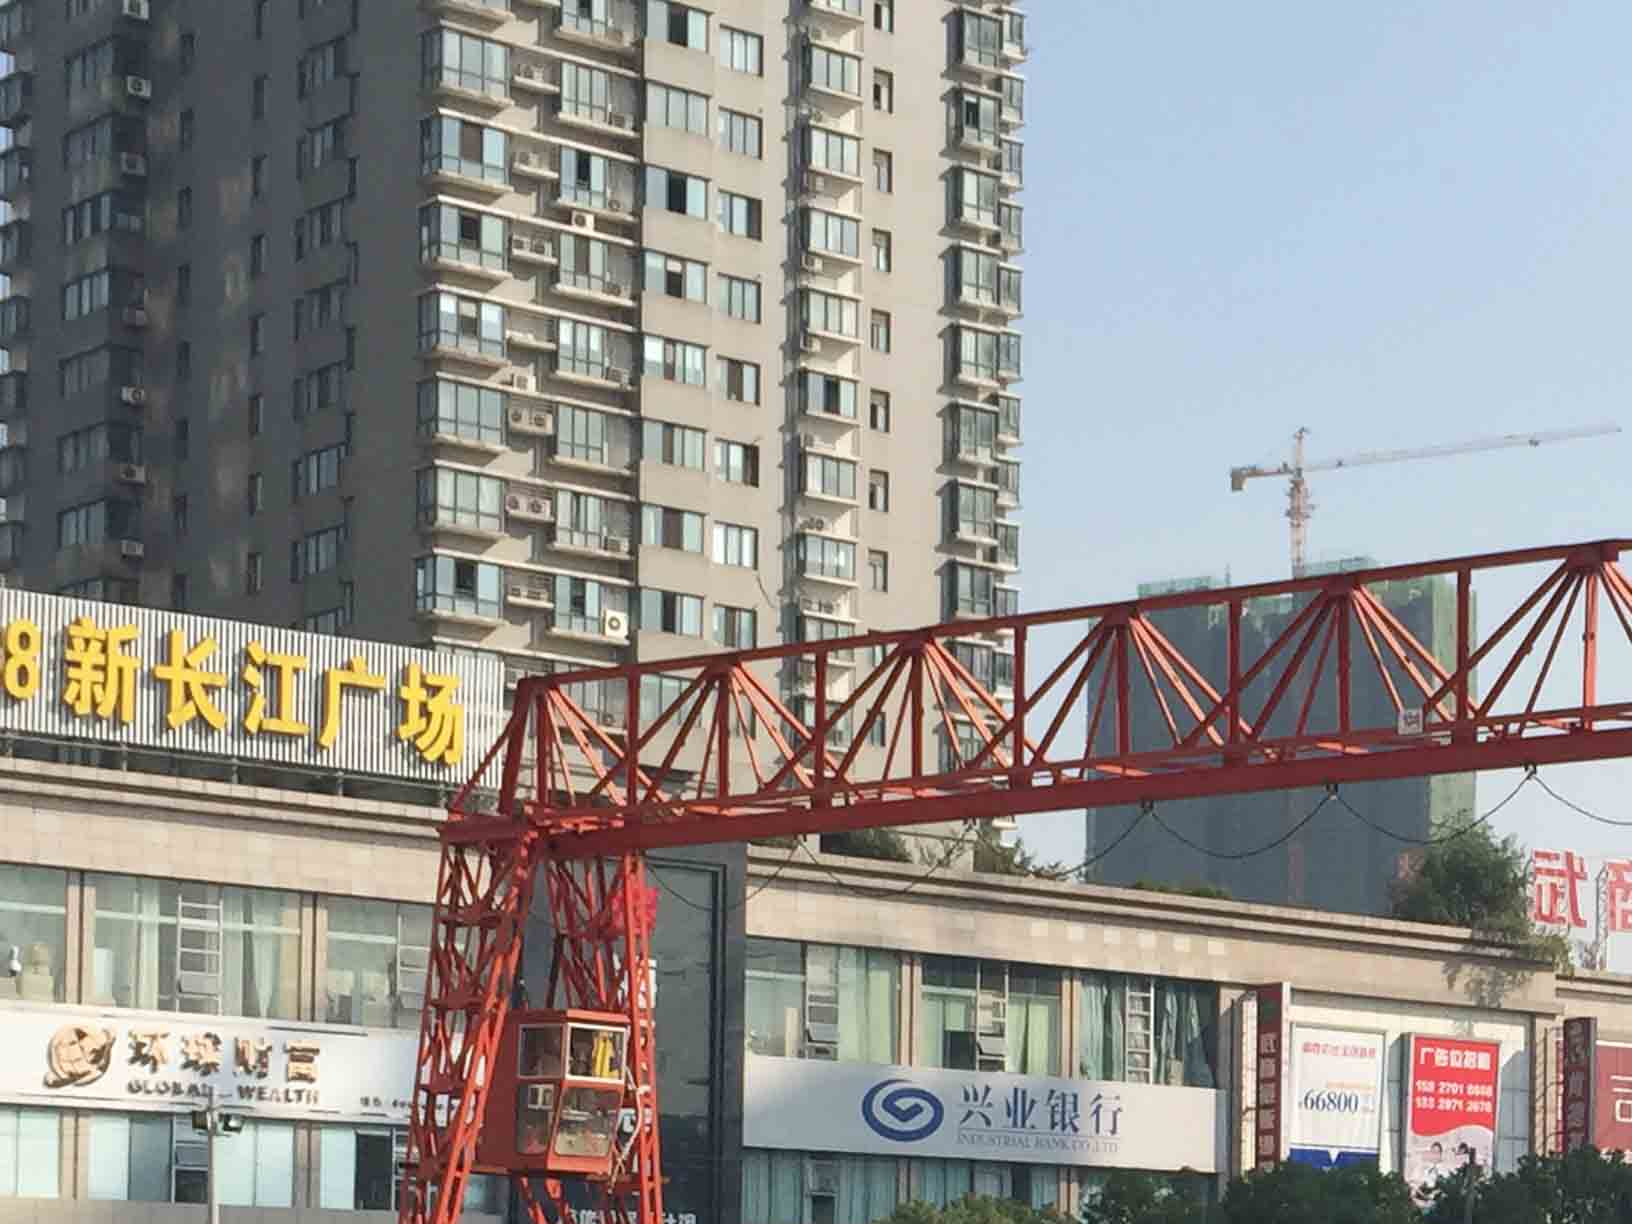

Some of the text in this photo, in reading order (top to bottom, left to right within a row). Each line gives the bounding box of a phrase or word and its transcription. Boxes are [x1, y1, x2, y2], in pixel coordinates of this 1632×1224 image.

[237, 1083, 319, 1105] WEALTH
[1303, 1088, 1360, 1114] 66800
[956, 1083, 1123, 1135] 兴业银行
